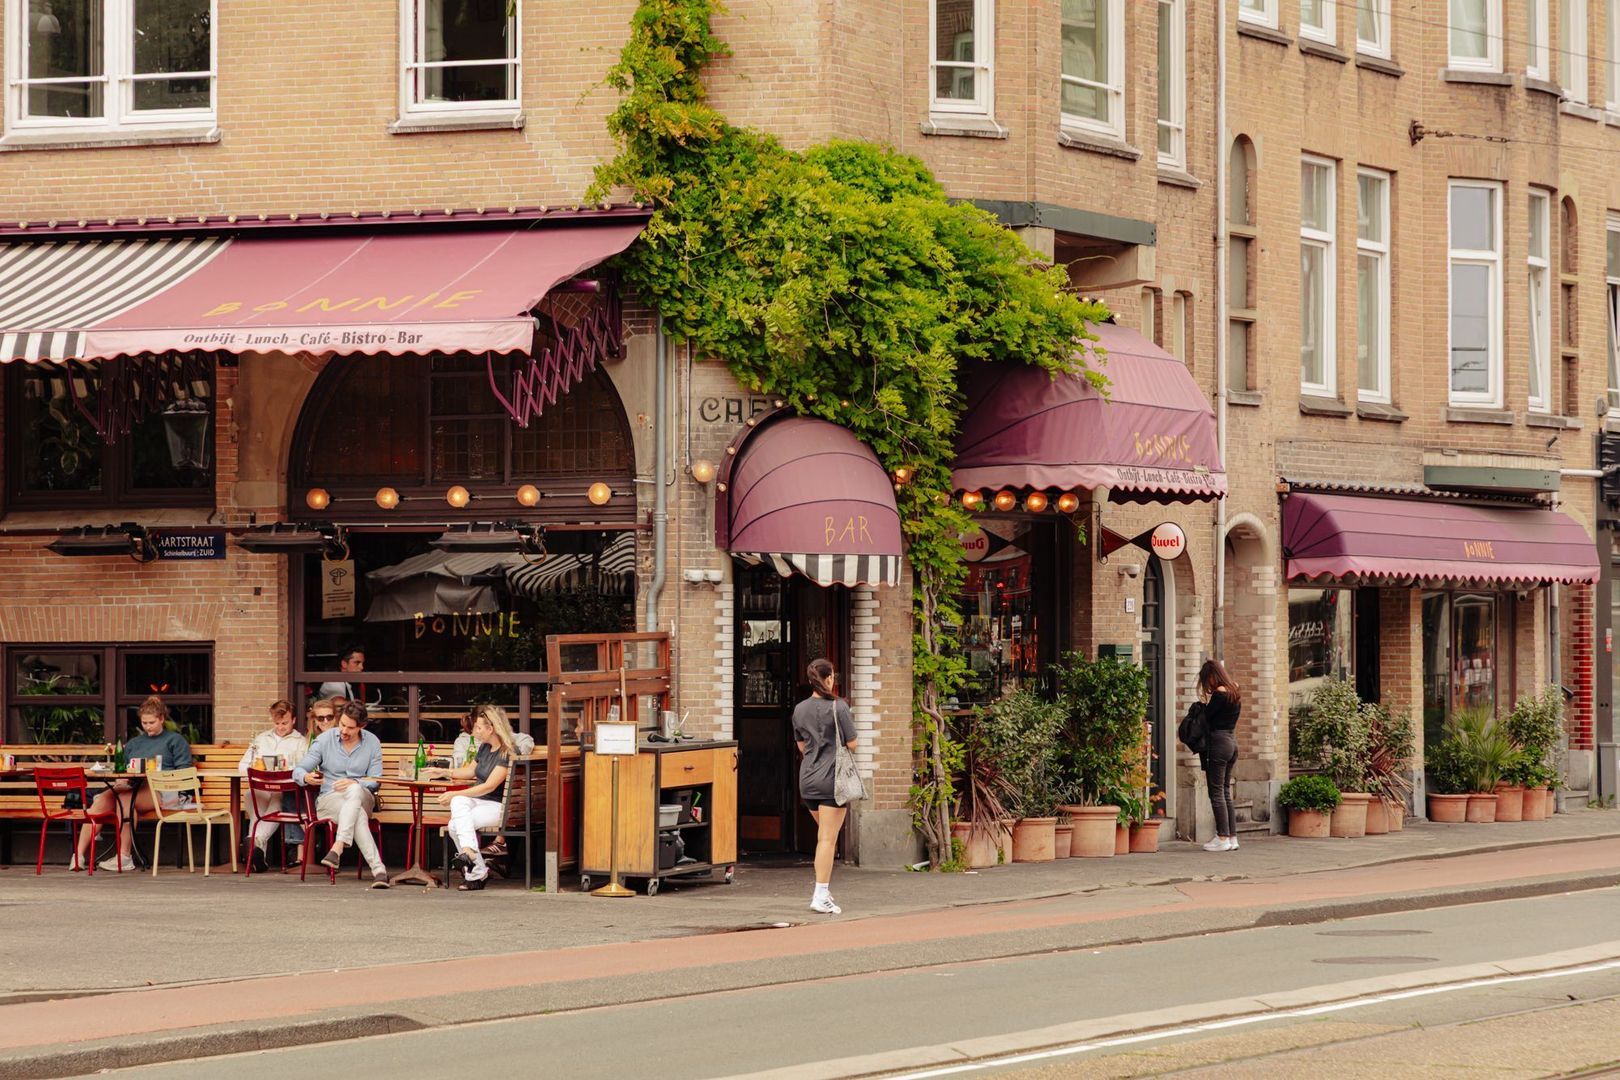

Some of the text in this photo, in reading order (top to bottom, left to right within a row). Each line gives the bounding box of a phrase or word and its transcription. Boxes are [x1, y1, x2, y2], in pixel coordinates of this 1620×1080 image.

[202, 289, 483, 318] BONNIE
[183, 332, 236, 346] Ontbijt
[246, 333, 289, 345] Lunch
[300, 331, 331, 346] Café
[341, 331, 387, 345] Bistro
[397, 331, 423, 345] Bar
[825, 515, 874, 546] BAR
[158, 536, 215, 548] AARTSTRAAT
